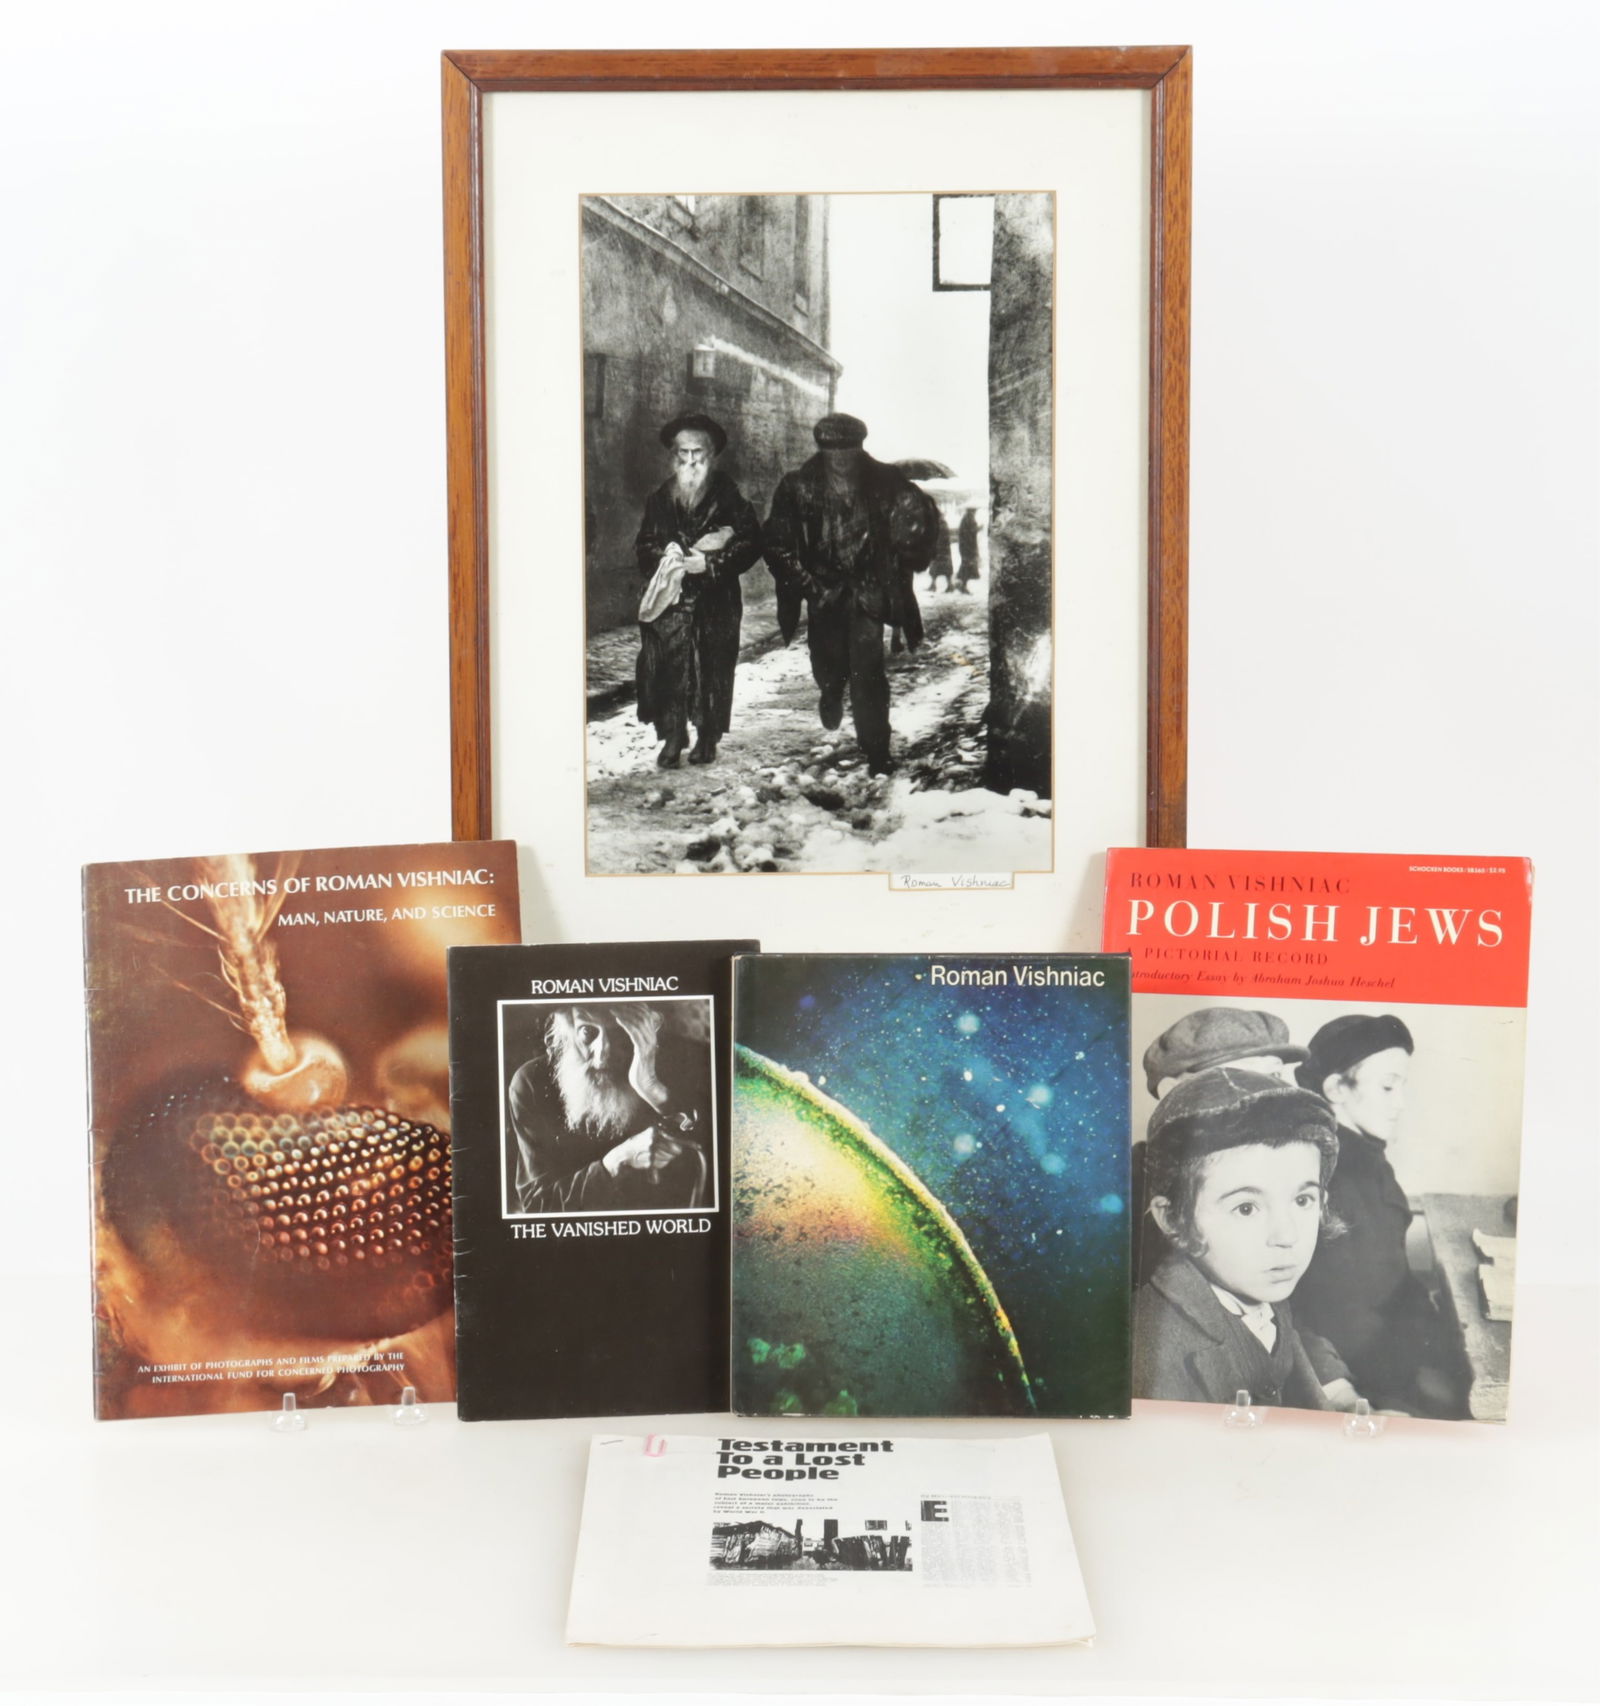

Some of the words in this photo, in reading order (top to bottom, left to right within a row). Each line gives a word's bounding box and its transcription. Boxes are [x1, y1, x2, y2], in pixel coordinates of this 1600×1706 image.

[124, 886, 162, 904] THE
[167, 879, 277, 901] CONCERNS
[283, 876, 312, 894] OF
[316, 871, 393, 893] ROMAN
[397, 868, 495, 888] VISHNIAC:
[901, 874, 942, 889] Roman
[951, 874, 1011, 888] Vishniac
[1130, 872, 1217, 890] ROMAN
[1229, 874, 1351, 894] VISHNIAC
[277, 911, 320, 927] MAN,
[324, 908, 387, 925] NATURE,
[391, 905, 426, 920] AND
[432, 904, 496, 919] SCIENCE
[1126, 899, 1340, 942] POLISH
[1360, 905, 1503, 948] JEWS
[1144, 947, 1242, 963] PICTORIAL
[1252, 951, 1328, 966] RECORD
[531, 978, 594, 994] ROMAN
[598, 976, 679, 993] VISHNIAC
[931, 965, 1008, 986] Roman
[1013, 965, 1105, 987] Vishniac
[1131, 970, 1193, 983] ntroductory
[1196, 971, 1227, 984] Essay
[1233, 972, 1245, 985] by
[1252, 973, 1301, 986] Abraham
[1305, 975, 1345, 988] Joshua
[1349, 977, 1396, 989] Heschel
[510, 1223, 547, 1239] THE
[551, 1220, 642, 1238] VANISHED
[645, 1218, 712, 1234] WORLD
[137, 1365, 151, 1373] AN
[153, 1363, 187, 1372] EXHIBIT
[190, 1362, 202, 1371] OF
[205, 1358, 273, 1369] PHOTOGRAPHS
[277, 1357, 296, 1365] AND
[299, 1355, 325, 1364] FILMS
[374, 1352, 386, 1360] BY
[388, 1352, 404, 1360] THE
[152, 1372, 224, 1384] INTERNATIONAL
[227, 1371, 253, 1379] FUND
[256, 1369, 275, 1378] FOR
[278, 1366, 334, 1377] CONCERNED
[336, 1363, 405, 1374] PHOTOGRAPHY
[718, 1438, 894, 1452] Testament
[716, 1451, 753, 1465] To
[763, 1454, 783, 1465] a
[795, 1453, 866, 1466] Lost
[717, 1465, 840, 1481] People
[920, 1500, 949, 1522] E
